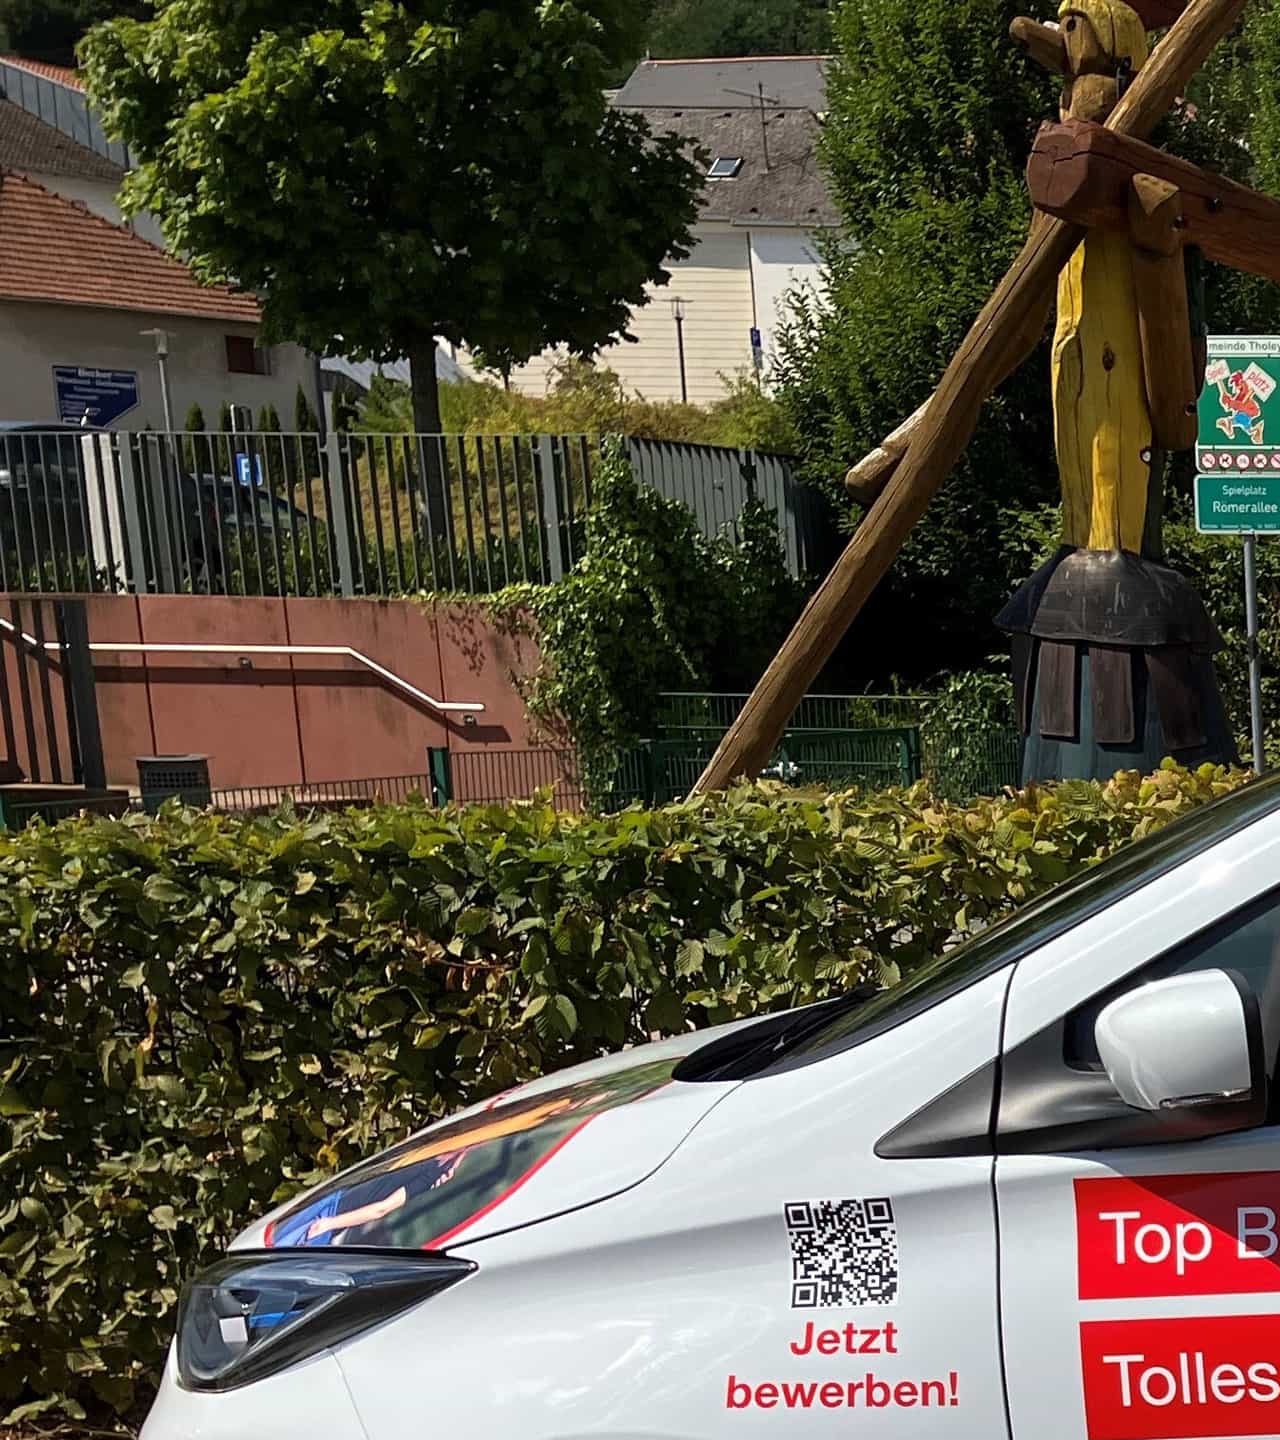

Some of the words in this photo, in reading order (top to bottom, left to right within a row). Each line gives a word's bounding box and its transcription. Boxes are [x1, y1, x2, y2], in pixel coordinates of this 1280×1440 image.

[1208, 342, 1246, 351] meinde
[1247, 371, 1271, 393] platz
[1222, 485, 1267, 496] Spielplatz
[1100, 1212, 1212, 1274] Top
[790, 1321, 898, 1356] Jetzt
[726, 1373, 959, 1409] bewerben!
[1103, 1352, 1280, 1406] Tolles
